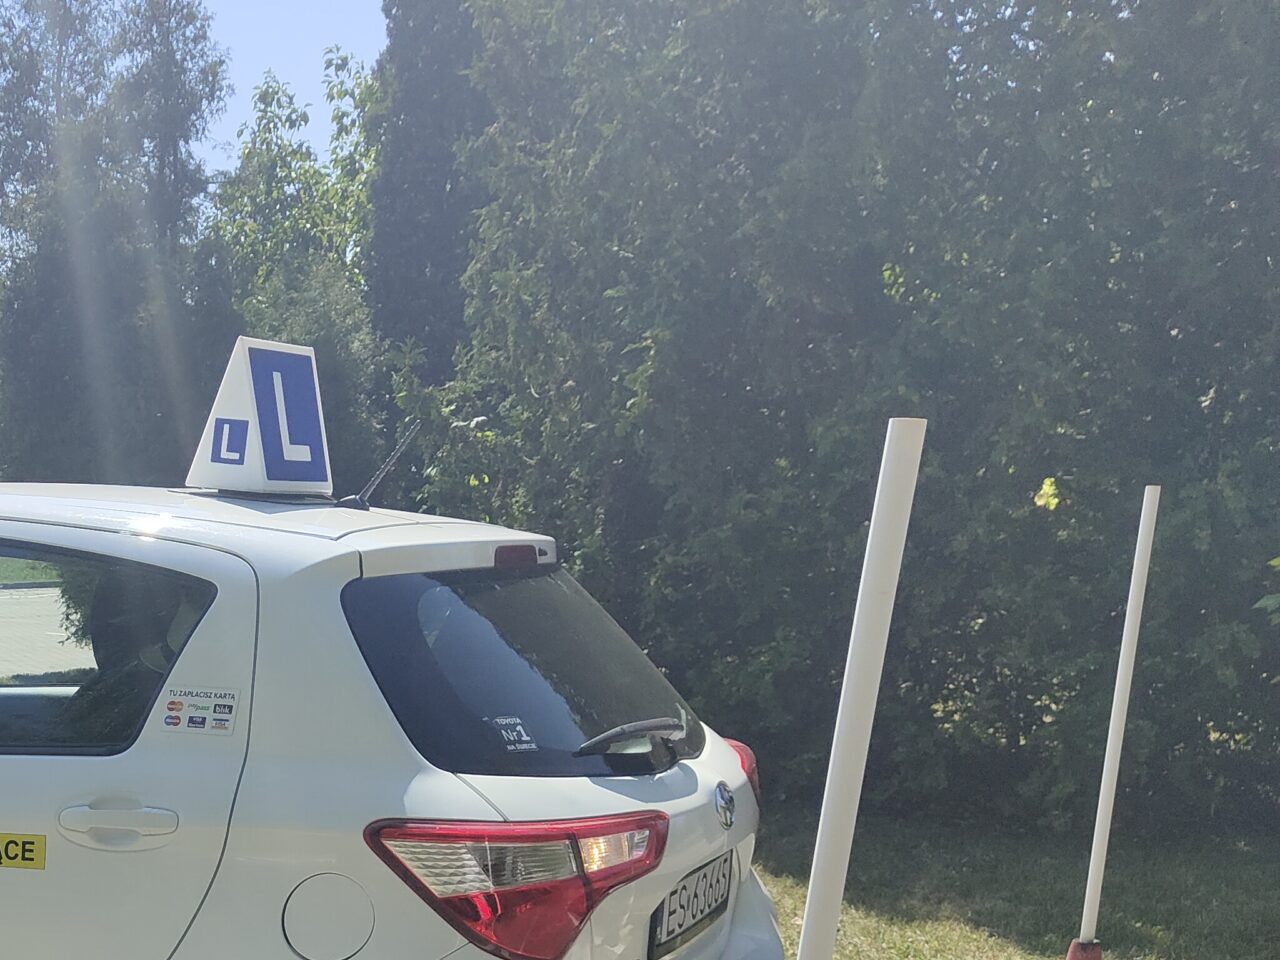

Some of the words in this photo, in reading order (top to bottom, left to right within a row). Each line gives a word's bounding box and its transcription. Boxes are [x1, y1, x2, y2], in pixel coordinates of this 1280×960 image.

[272, 371, 312, 462] L
[220, 423, 240, 460] L
[169, 689, 178, 697] TU
[495, 717, 522, 725] TOYOTA
[666, 884, 688, 939] ES
